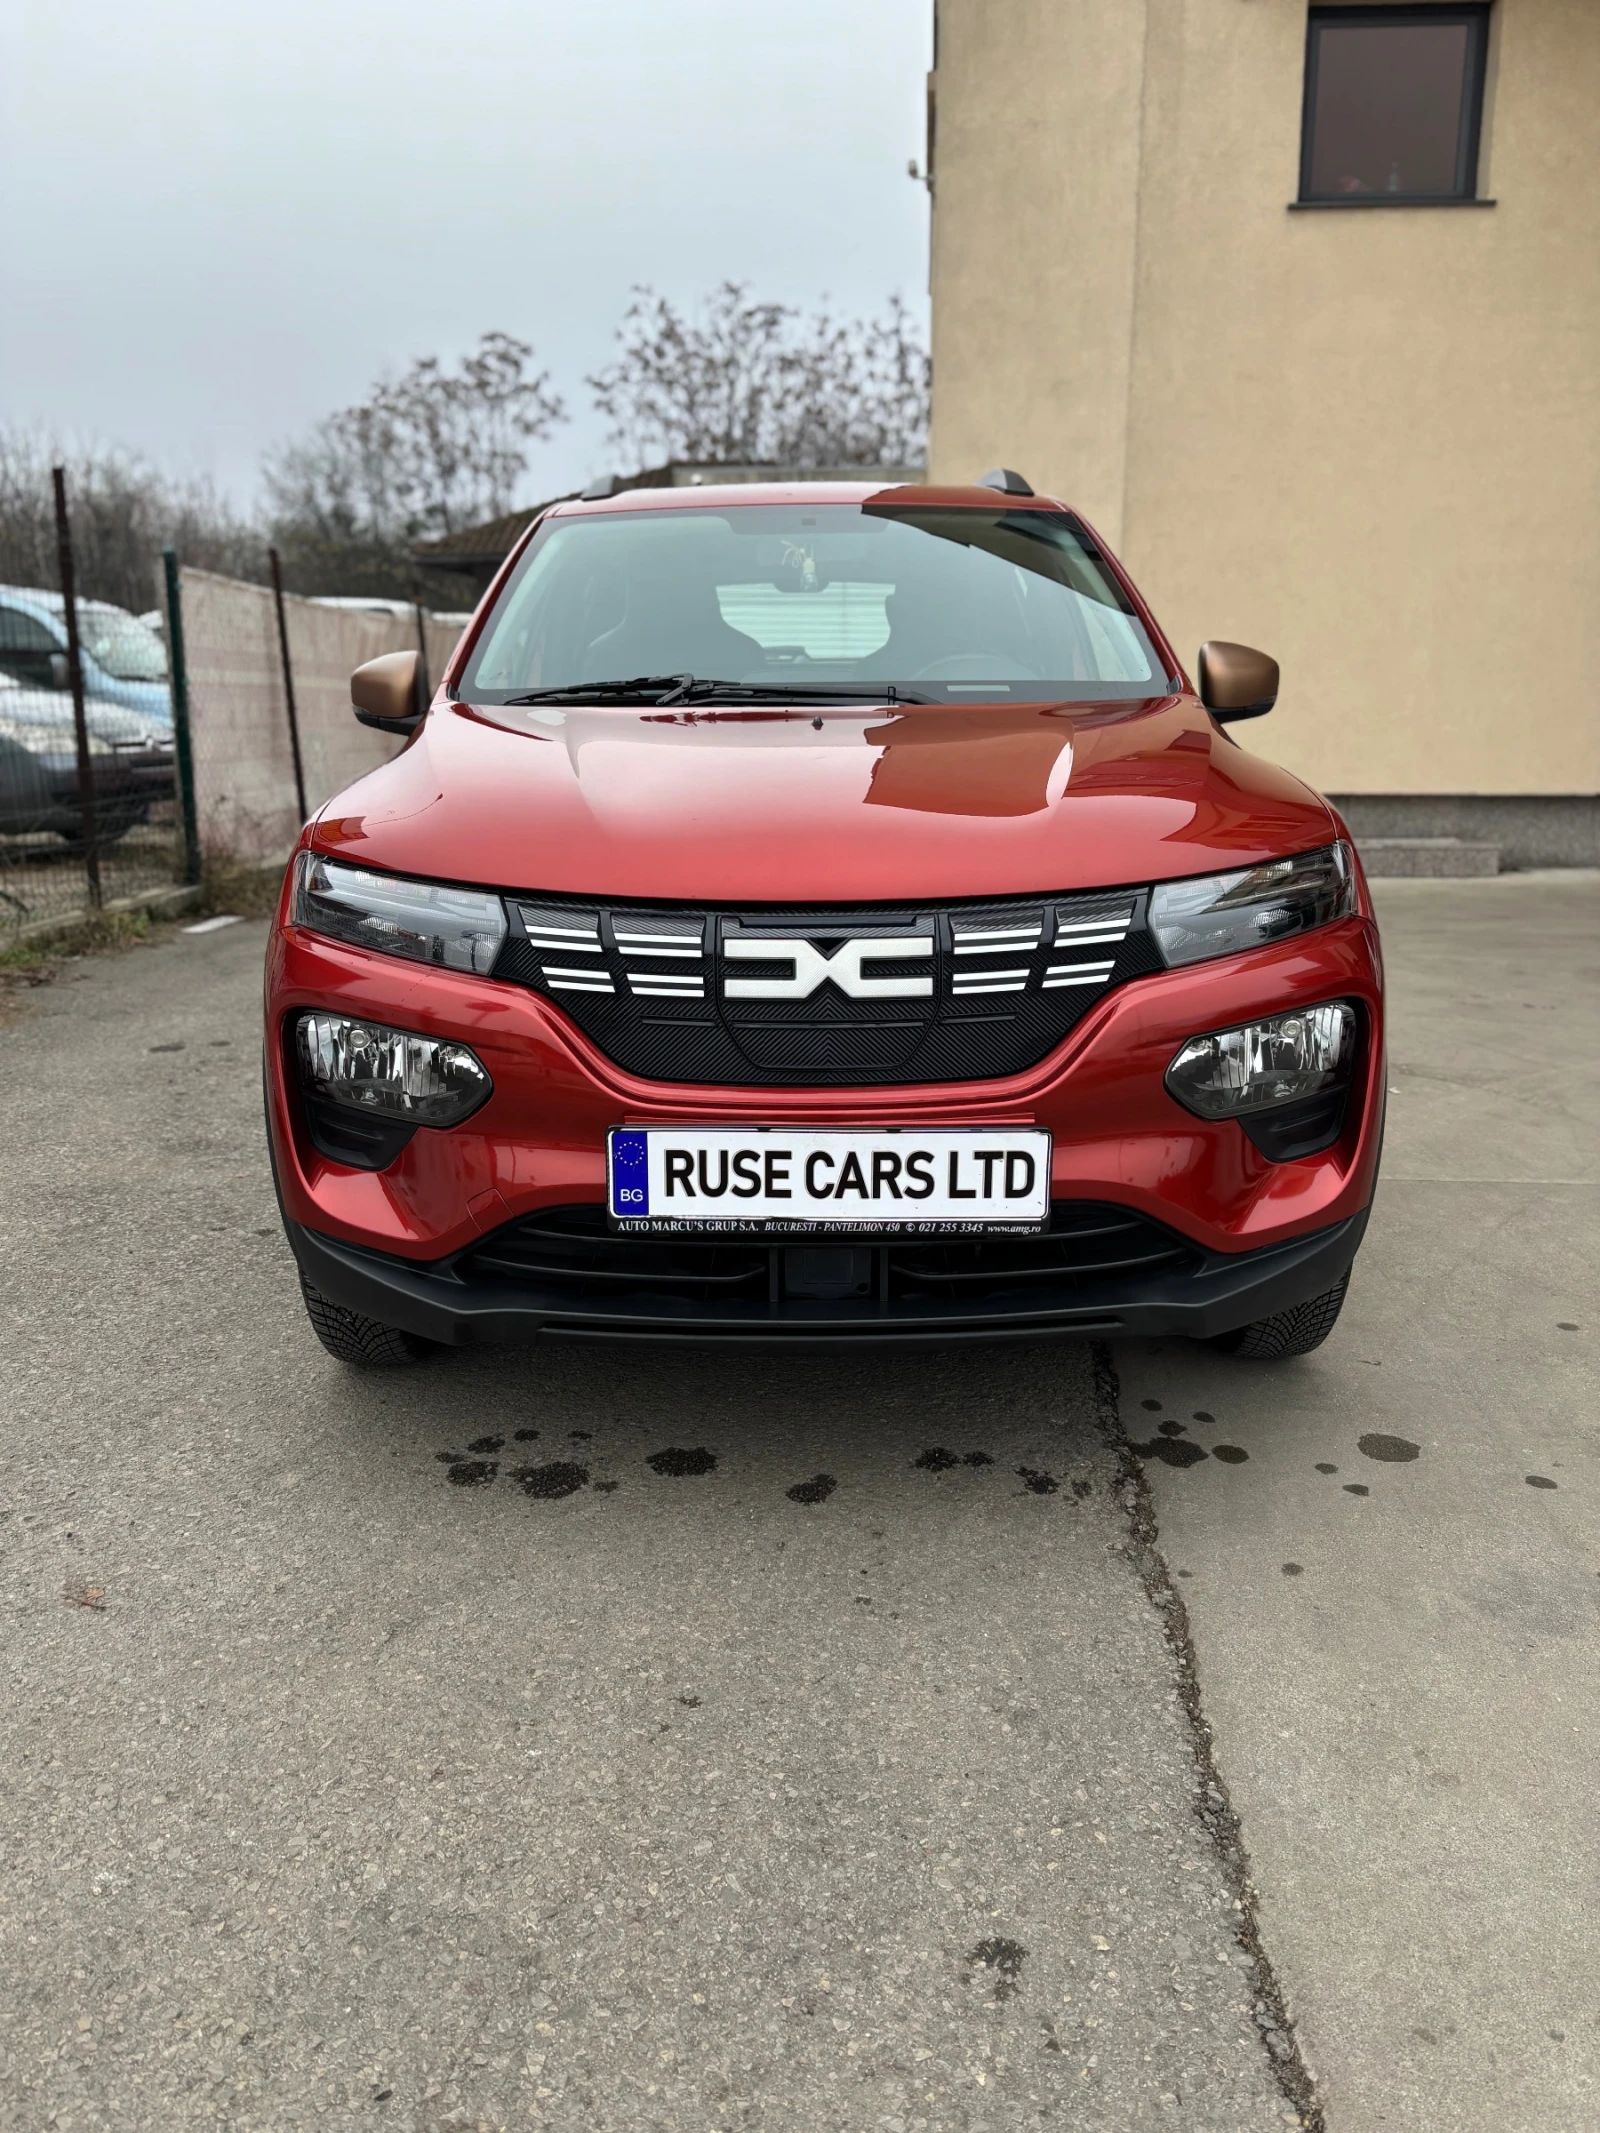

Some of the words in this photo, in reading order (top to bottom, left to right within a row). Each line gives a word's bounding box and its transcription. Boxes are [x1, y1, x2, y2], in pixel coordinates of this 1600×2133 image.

[664, 1149, 792, 1198] RUSE
[805, 1150, 935, 1200] CARS
[949, 1151, 1036, 1199] LTD
[620, 1188, 643, 1202] BG
[617, 1220, 649, 1231] AUTO
[651, 1220, 704, 1231] MARCU'S
[706, 1220, 738, 1231] GRUP
[739, 1221, 759, 1231] S.A.
[764, 1221, 817, 1232] BUCURESTI
[823, 1222, 884, 1232] PANTELIMON
[885, 1222, 901, 1232] 450
[918, 1222, 936, 1232] 021
[939, 1222, 957, 1232] 255
[959, 1222, 984, 1232] 3345
[987, 1224, 1041, 1235] www.amg.ro
